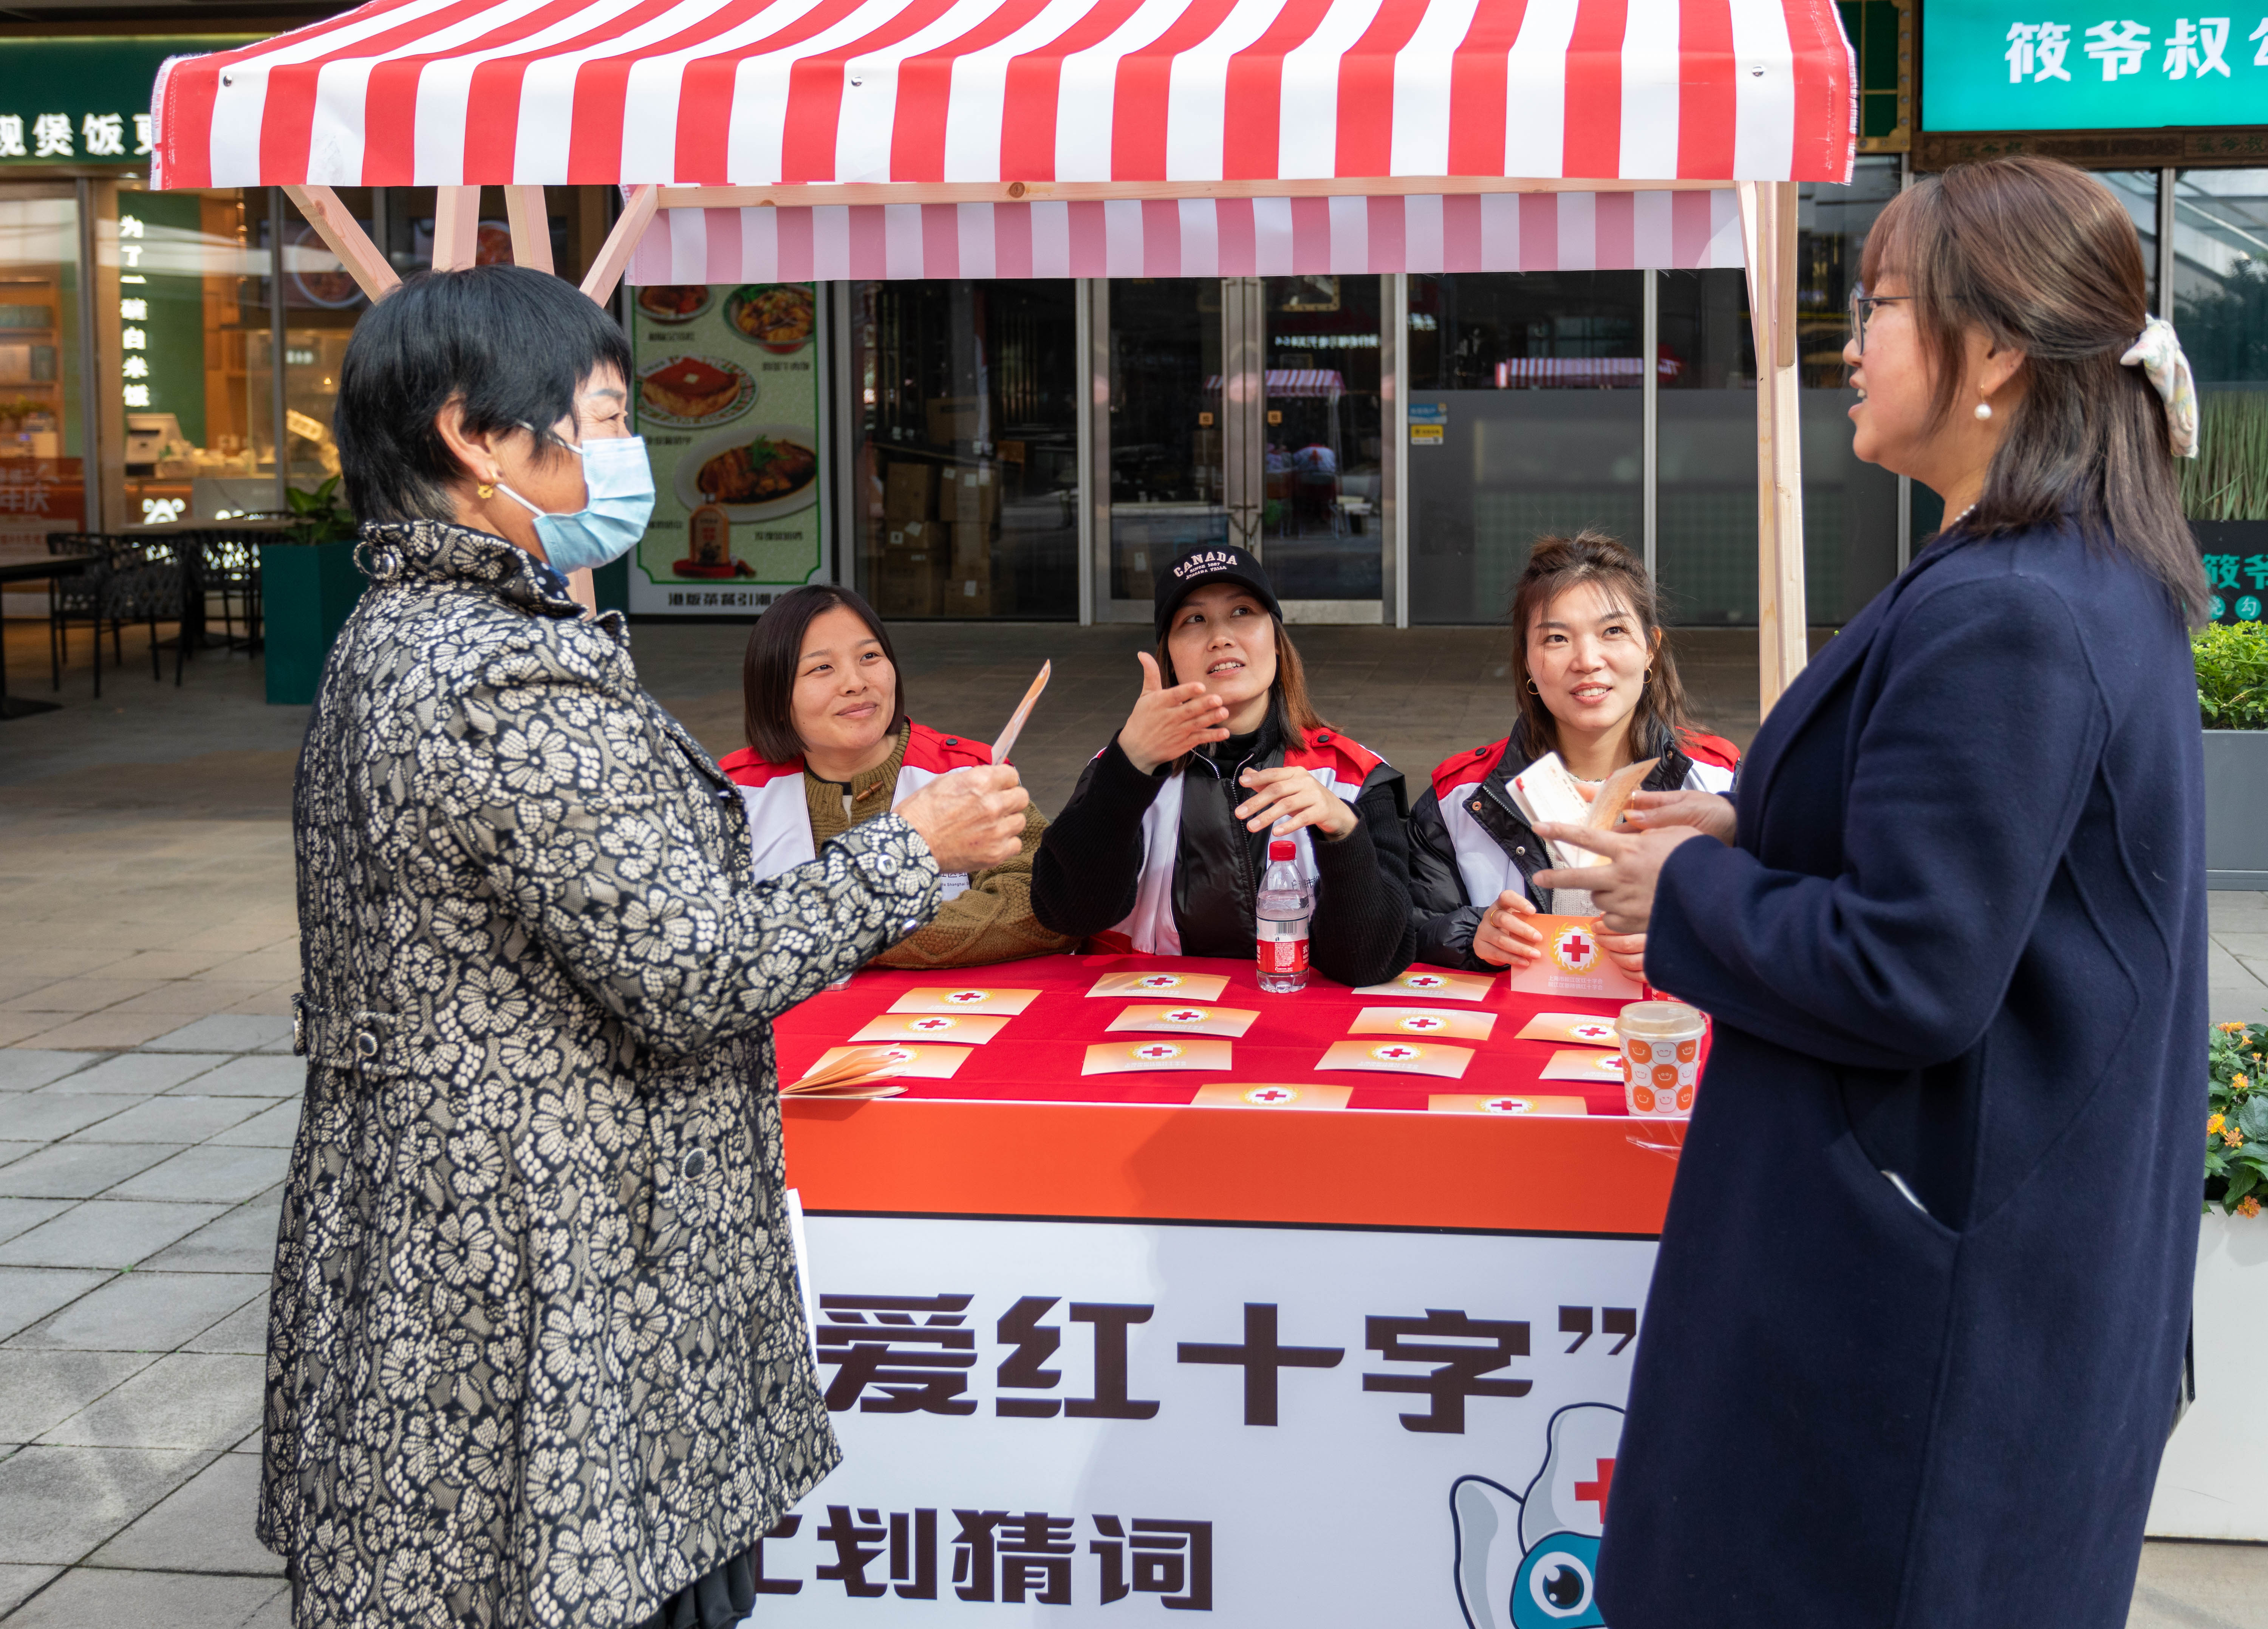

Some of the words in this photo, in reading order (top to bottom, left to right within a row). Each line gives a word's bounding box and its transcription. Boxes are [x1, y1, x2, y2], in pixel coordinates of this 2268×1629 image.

[1173, 551, 1238, 577] CANADA
[1189, 565, 1205, 573] SINCE
[1185, 569, 1208, 580] NIAGARA
[816, 1293, 1637, 1434] 爱红十字”
